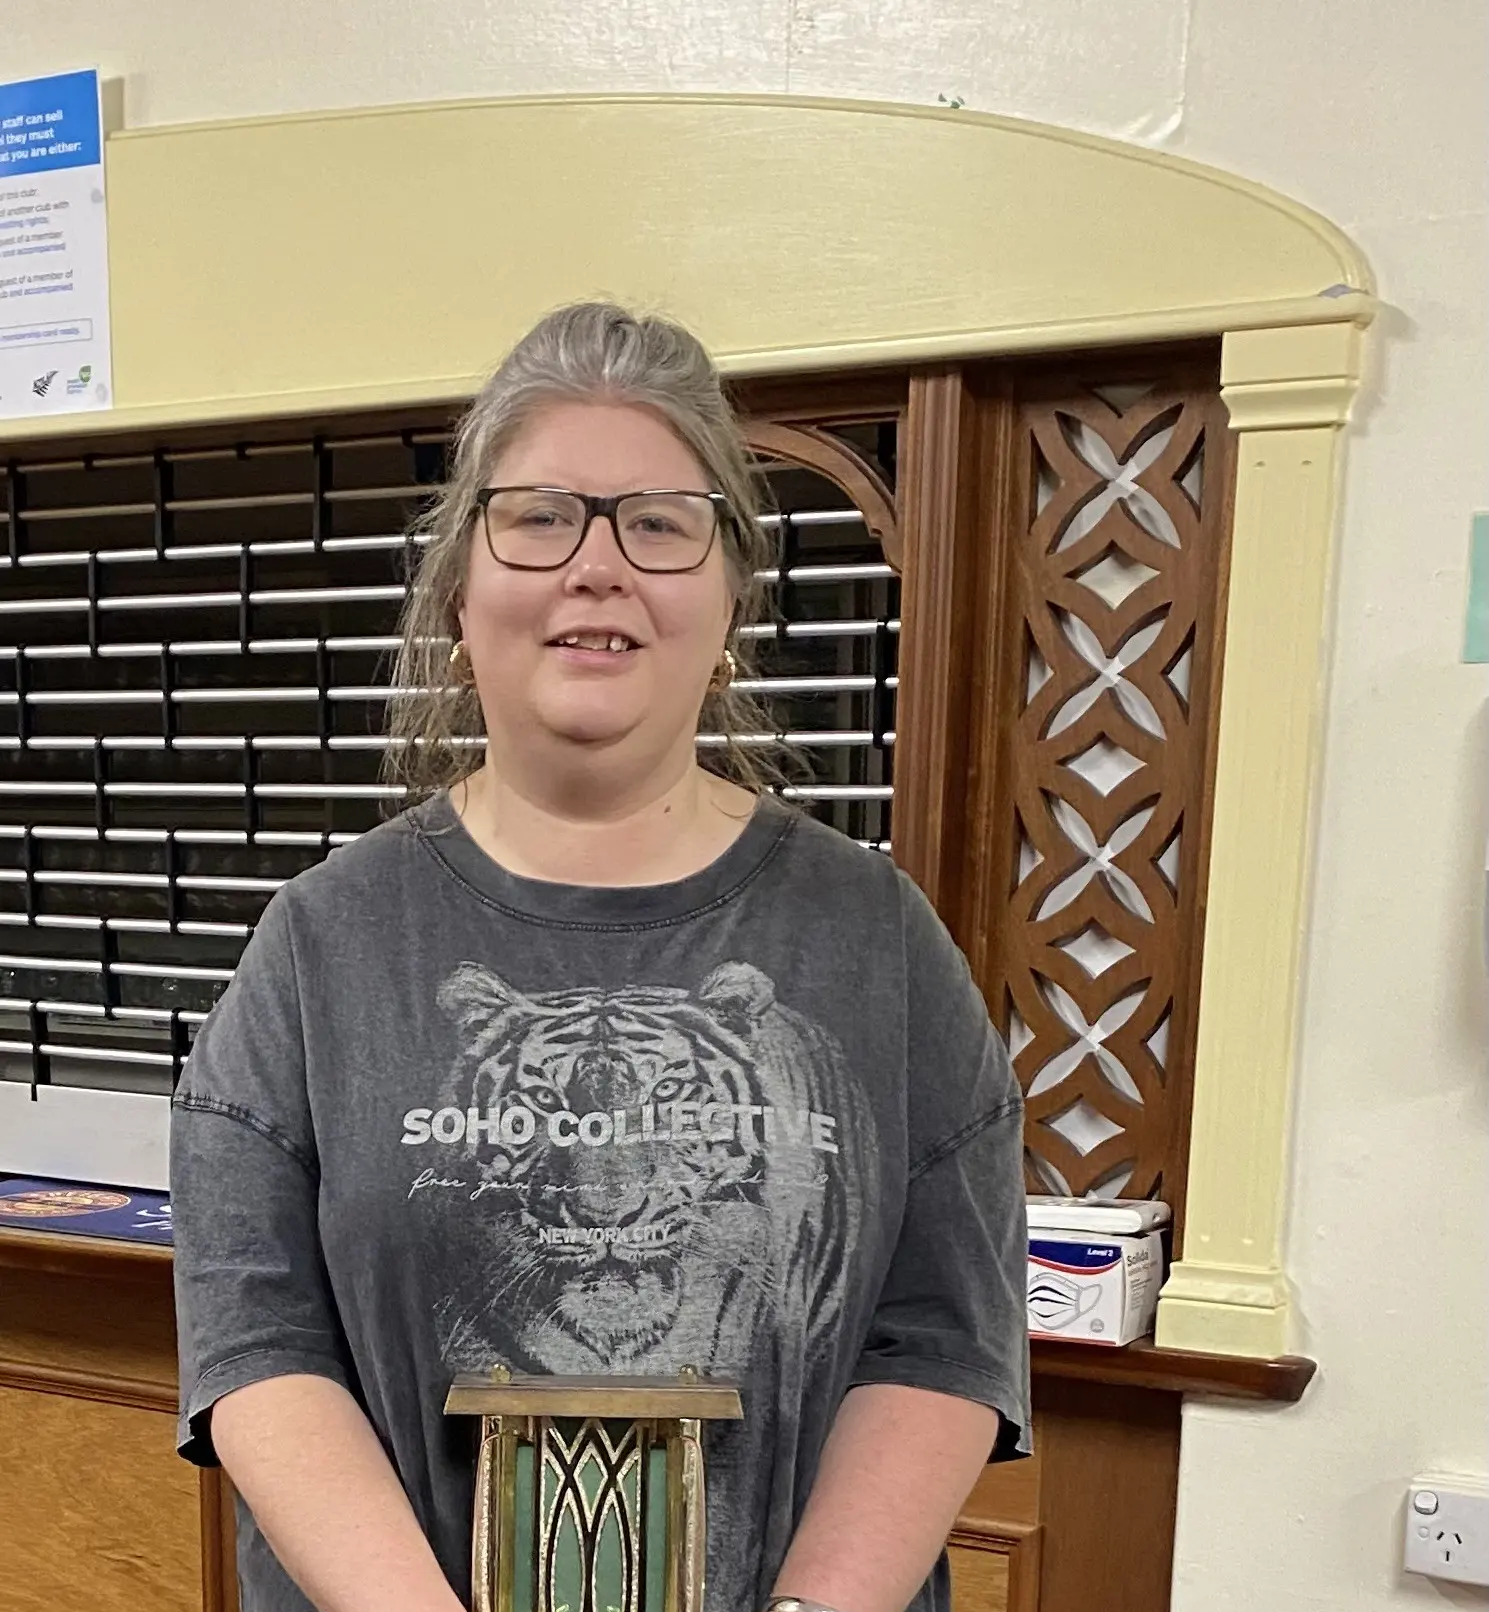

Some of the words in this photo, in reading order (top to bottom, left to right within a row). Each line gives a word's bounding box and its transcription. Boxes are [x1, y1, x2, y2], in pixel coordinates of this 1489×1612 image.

[26, 115, 43, 125] can
[45, 109, 63, 122] sell
[6, 133, 27, 145] they
[29, 127, 55, 140] must
[11, 150, 28, 162] you
[31, 147, 46, 157] are
[400, 1107, 537, 1146] SOHO
[548, 1101, 839, 1155] COLLECTIVE
[408, 1168, 466, 1199] free
[539, 1227, 577, 1244] NEW
[582, 1227, 629, 1244] YORK
[632, 1224, 672, 1242] CITY
